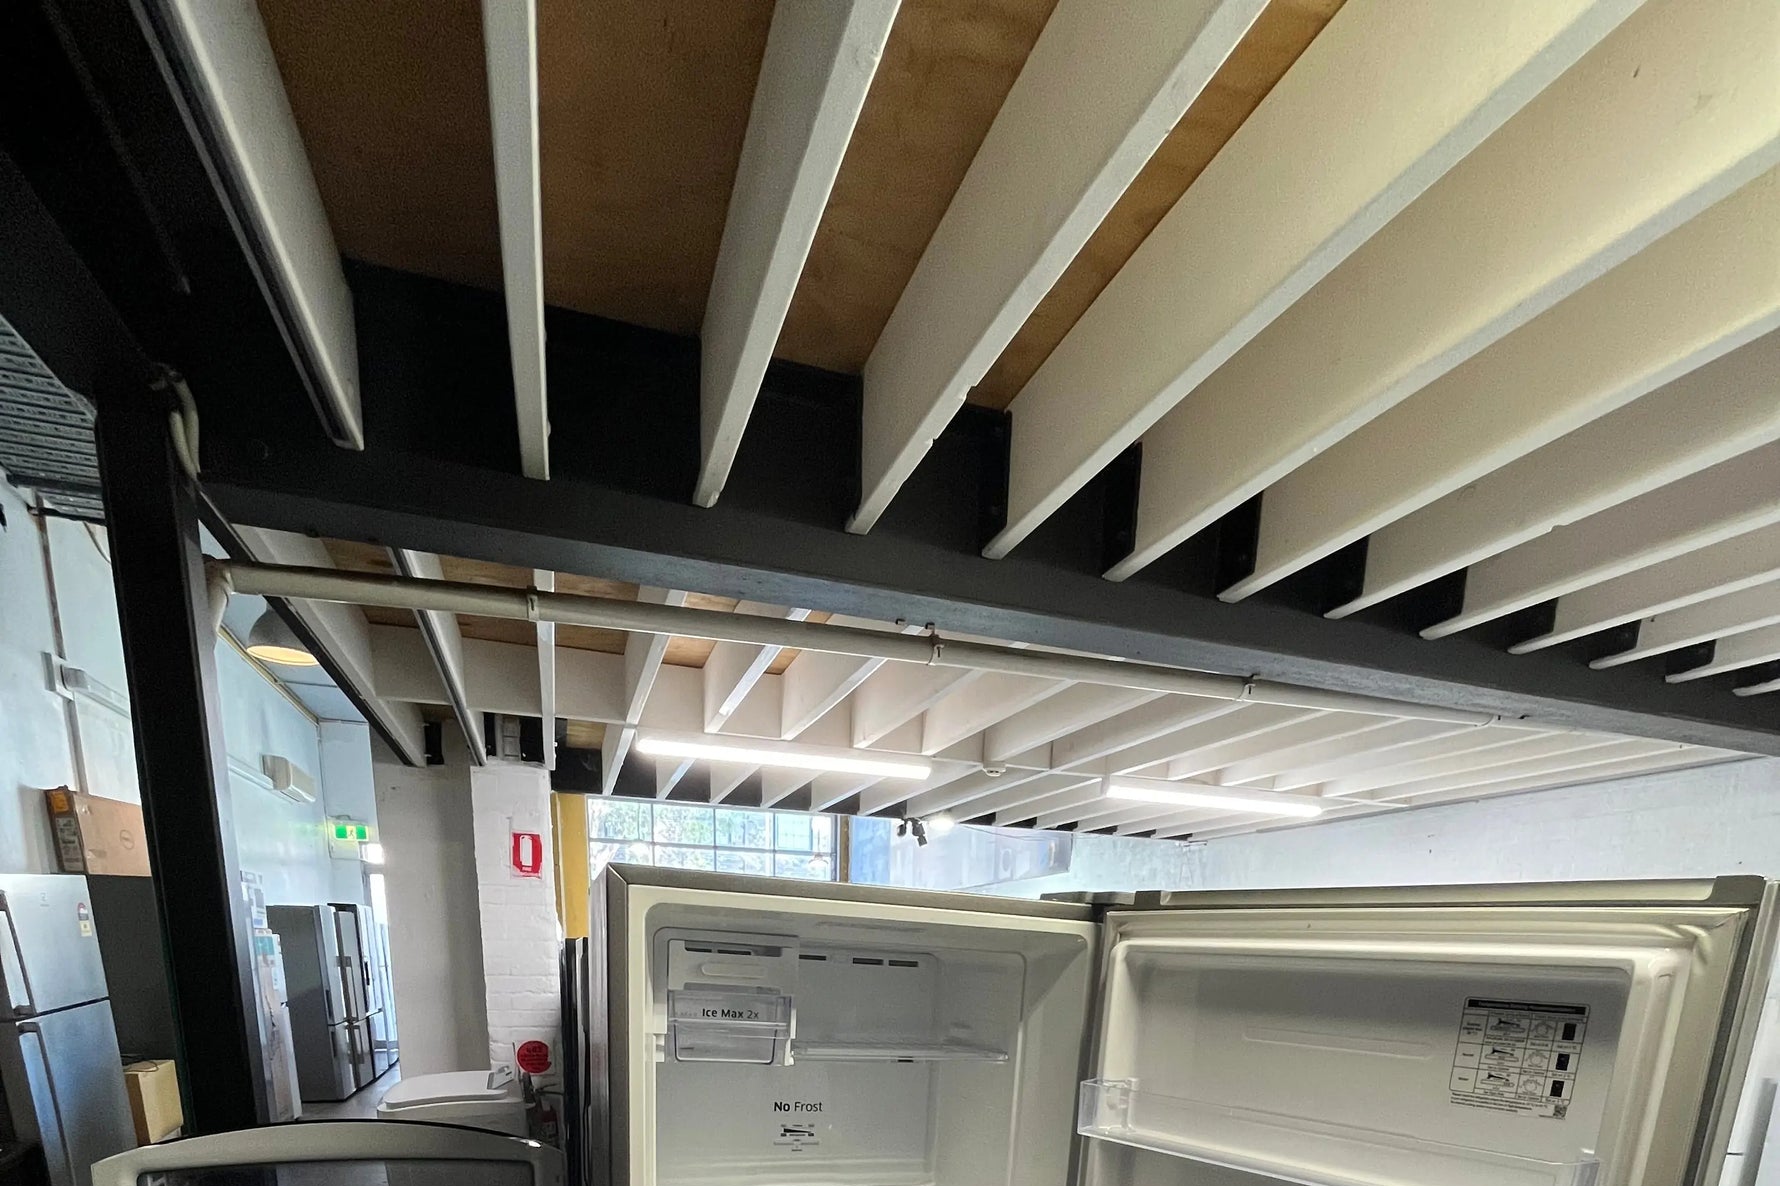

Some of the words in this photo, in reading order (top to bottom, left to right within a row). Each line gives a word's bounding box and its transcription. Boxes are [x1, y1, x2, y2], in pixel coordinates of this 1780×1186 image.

[702, 1008, 718, 1018] Ice
[721, 1008, 744, 1019] Max
[747, 1009, 759, 1019] 2x
[774, 1101, 790, 1112] No
[794, 1101, 823, 1112] Frost
